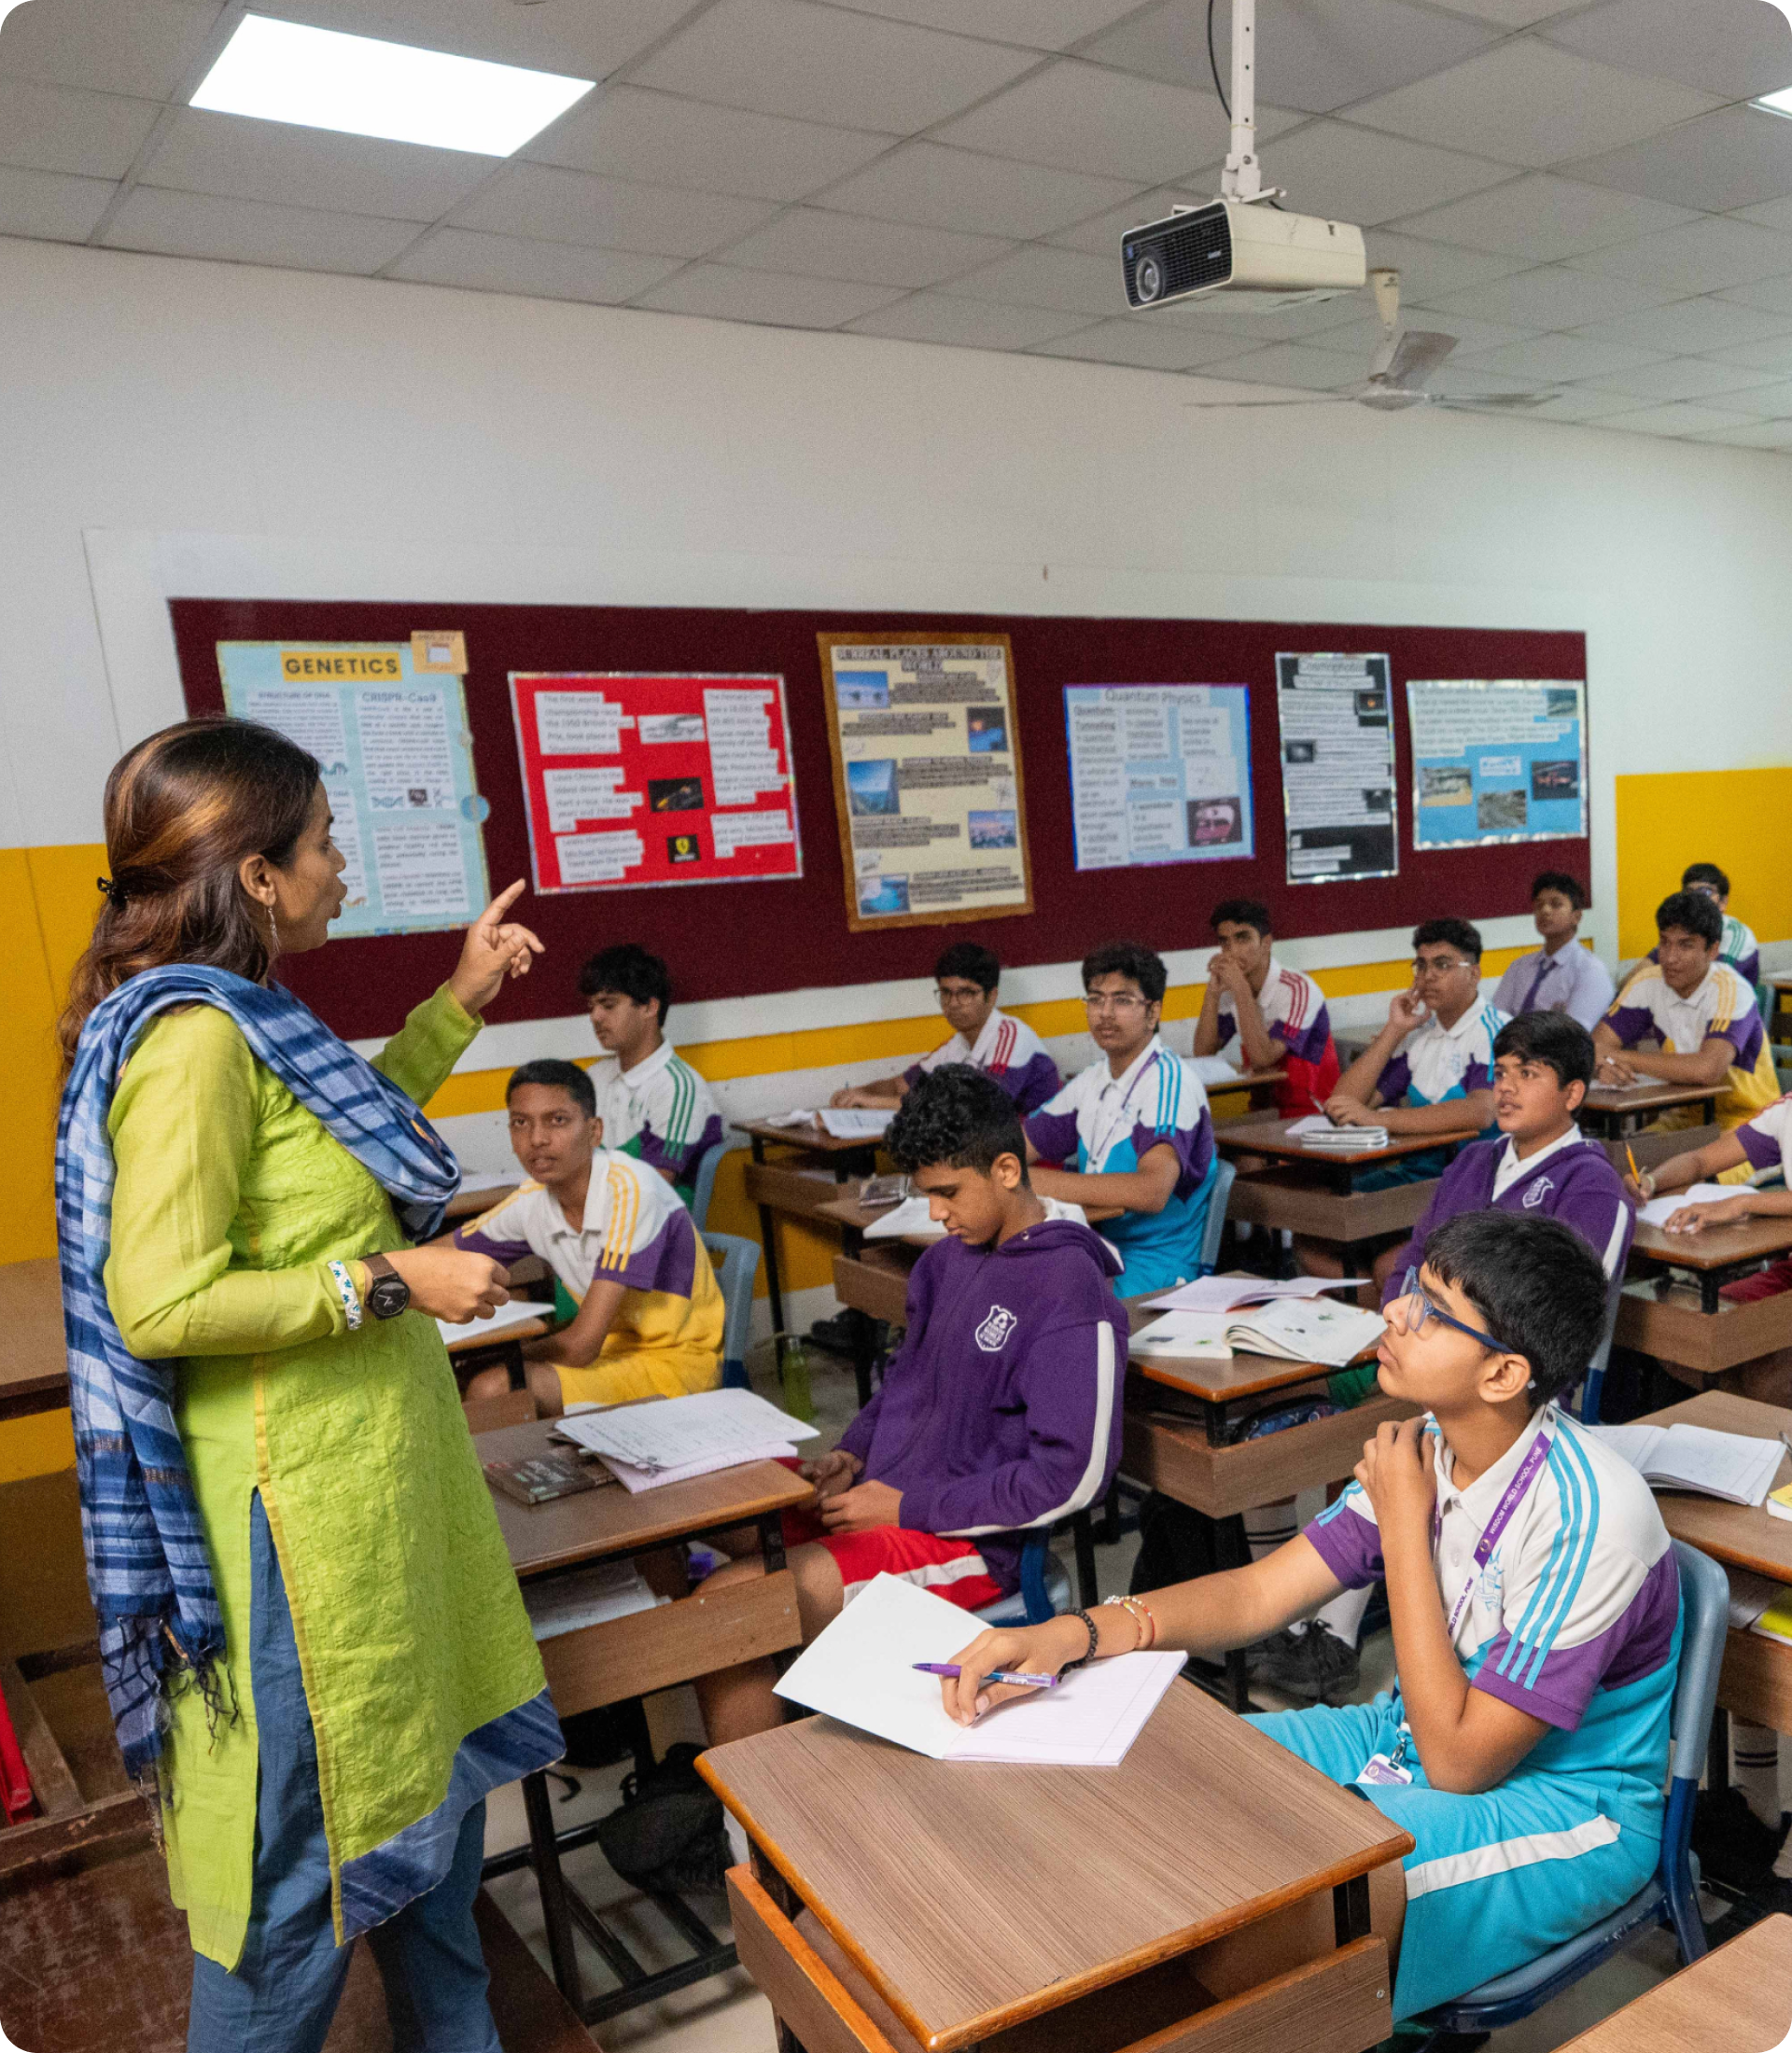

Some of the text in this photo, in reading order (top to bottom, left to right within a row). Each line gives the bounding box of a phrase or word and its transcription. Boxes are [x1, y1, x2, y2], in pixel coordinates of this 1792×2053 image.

[285, 657, 399, 675] GENETICS
[1105, 688, 1157, 703] Quantum
[1489, 1445, 1543, 1535] WISDOM WORLD SCHOOL, PUNE
